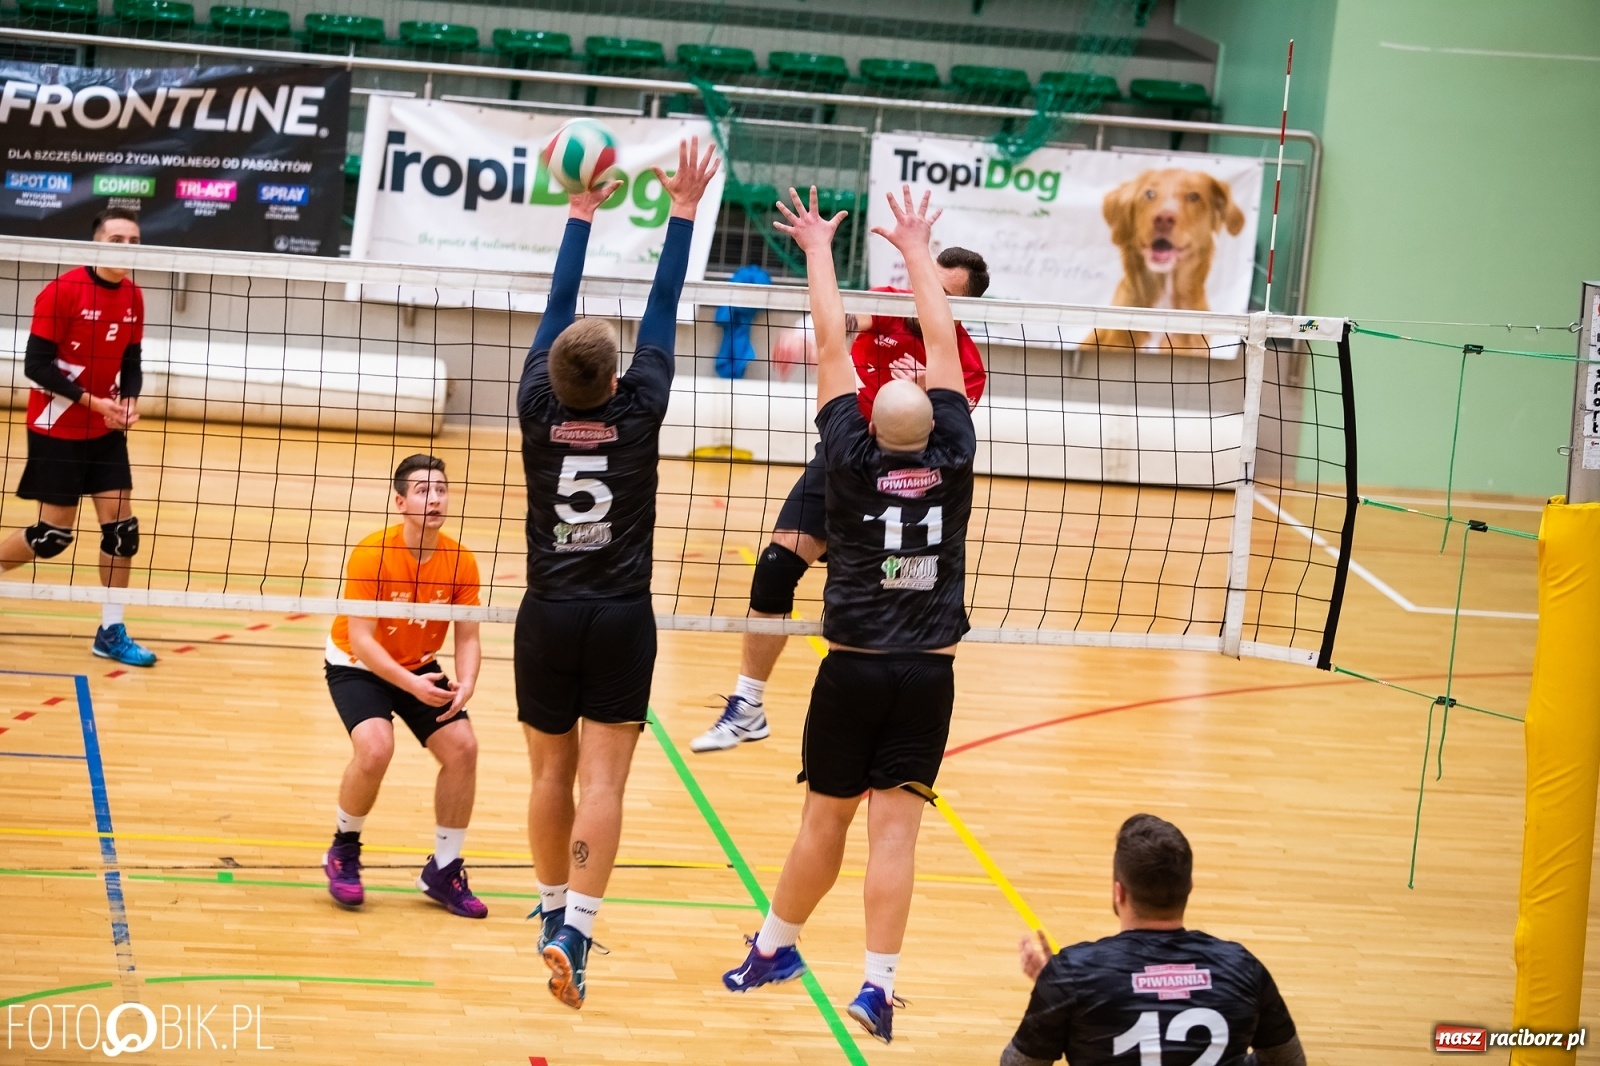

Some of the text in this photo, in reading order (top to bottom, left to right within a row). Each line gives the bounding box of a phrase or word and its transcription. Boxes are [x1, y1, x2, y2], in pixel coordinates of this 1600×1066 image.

[8, 148, 312, 173] DLA SZCZĘŚLIWEGO ŻYCIA WOLNEGO OD PASOŻYTÓW
[10, 173, 68, 190] SPOT ON
[894, 149, 1061, 202] TropiDog
[99, 178, 150, 194] COMBO
[261, 186, 305, 202] SPRAY
[105, 323, 119, 341] 2
[554, 455, 613, 524] 5
[882, 474, 938, 490] PIWIARNIA
[863, 505, 943, 550] 11
[1138, 974, 1206, 988] PIWIARNIA
[1113, 1008, 1229, 1066] 12
